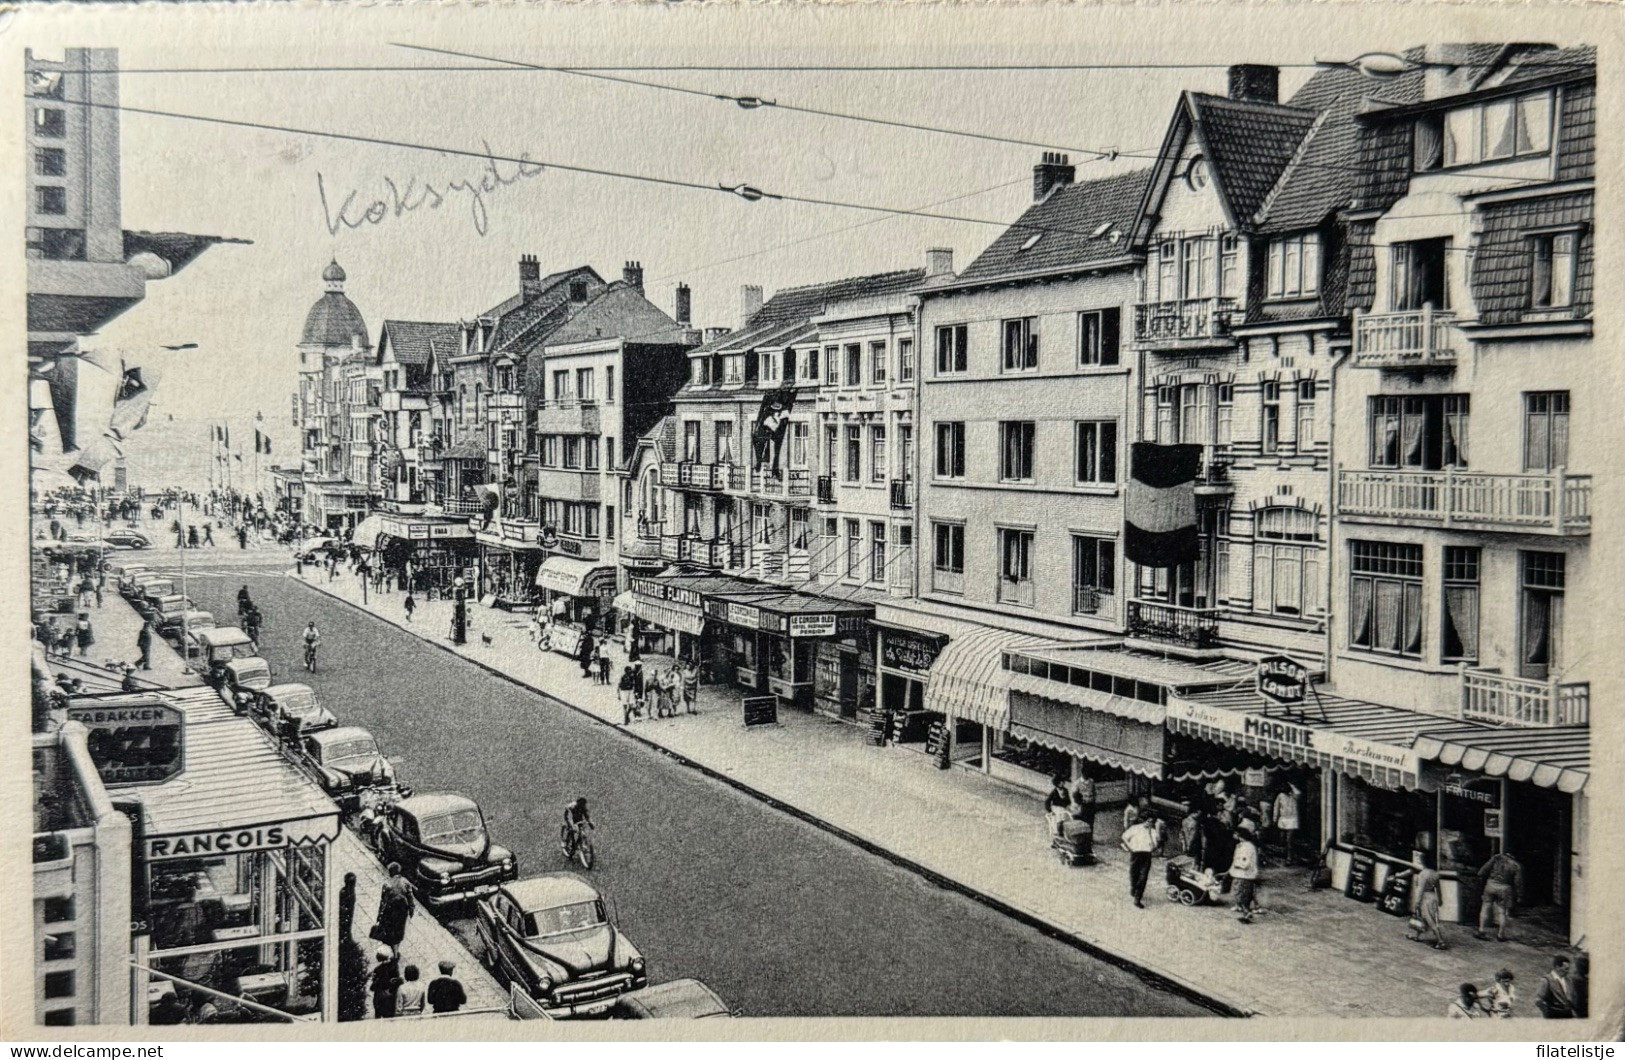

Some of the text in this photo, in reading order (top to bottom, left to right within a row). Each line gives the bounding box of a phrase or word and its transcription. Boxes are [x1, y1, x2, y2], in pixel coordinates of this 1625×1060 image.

[379, 419, 389, 490] GLACES
[69, 709, 165, 723] TABAKKEN
[1244, 716, 1314, 748] MARINE
